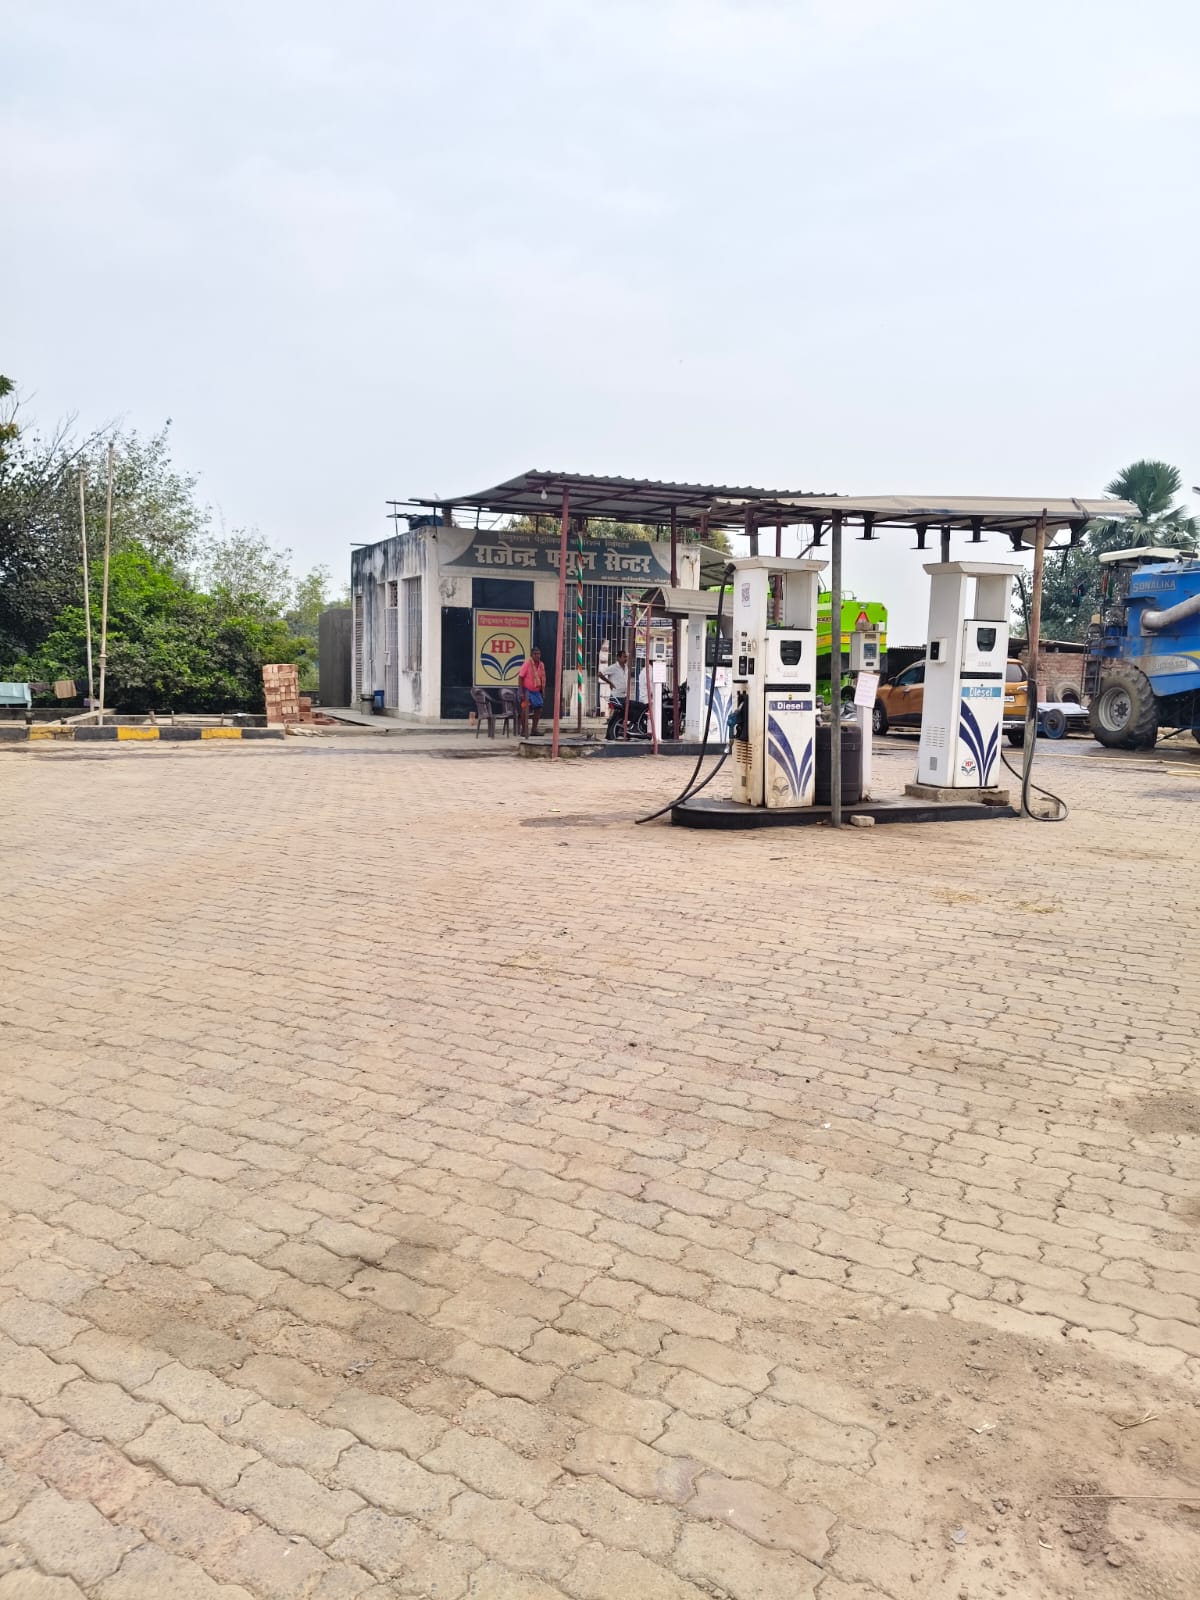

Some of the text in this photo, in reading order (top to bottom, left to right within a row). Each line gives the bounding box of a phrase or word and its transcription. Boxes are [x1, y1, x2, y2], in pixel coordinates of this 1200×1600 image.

[472, 541, 538, 567] राजेन्द्र
[603, 548, 652, 573] सेन्टर
[490, 639, 516, 654] HP
[969, 686, 993, 697] Diesel
[777, 702, 804, 710] Diesel
